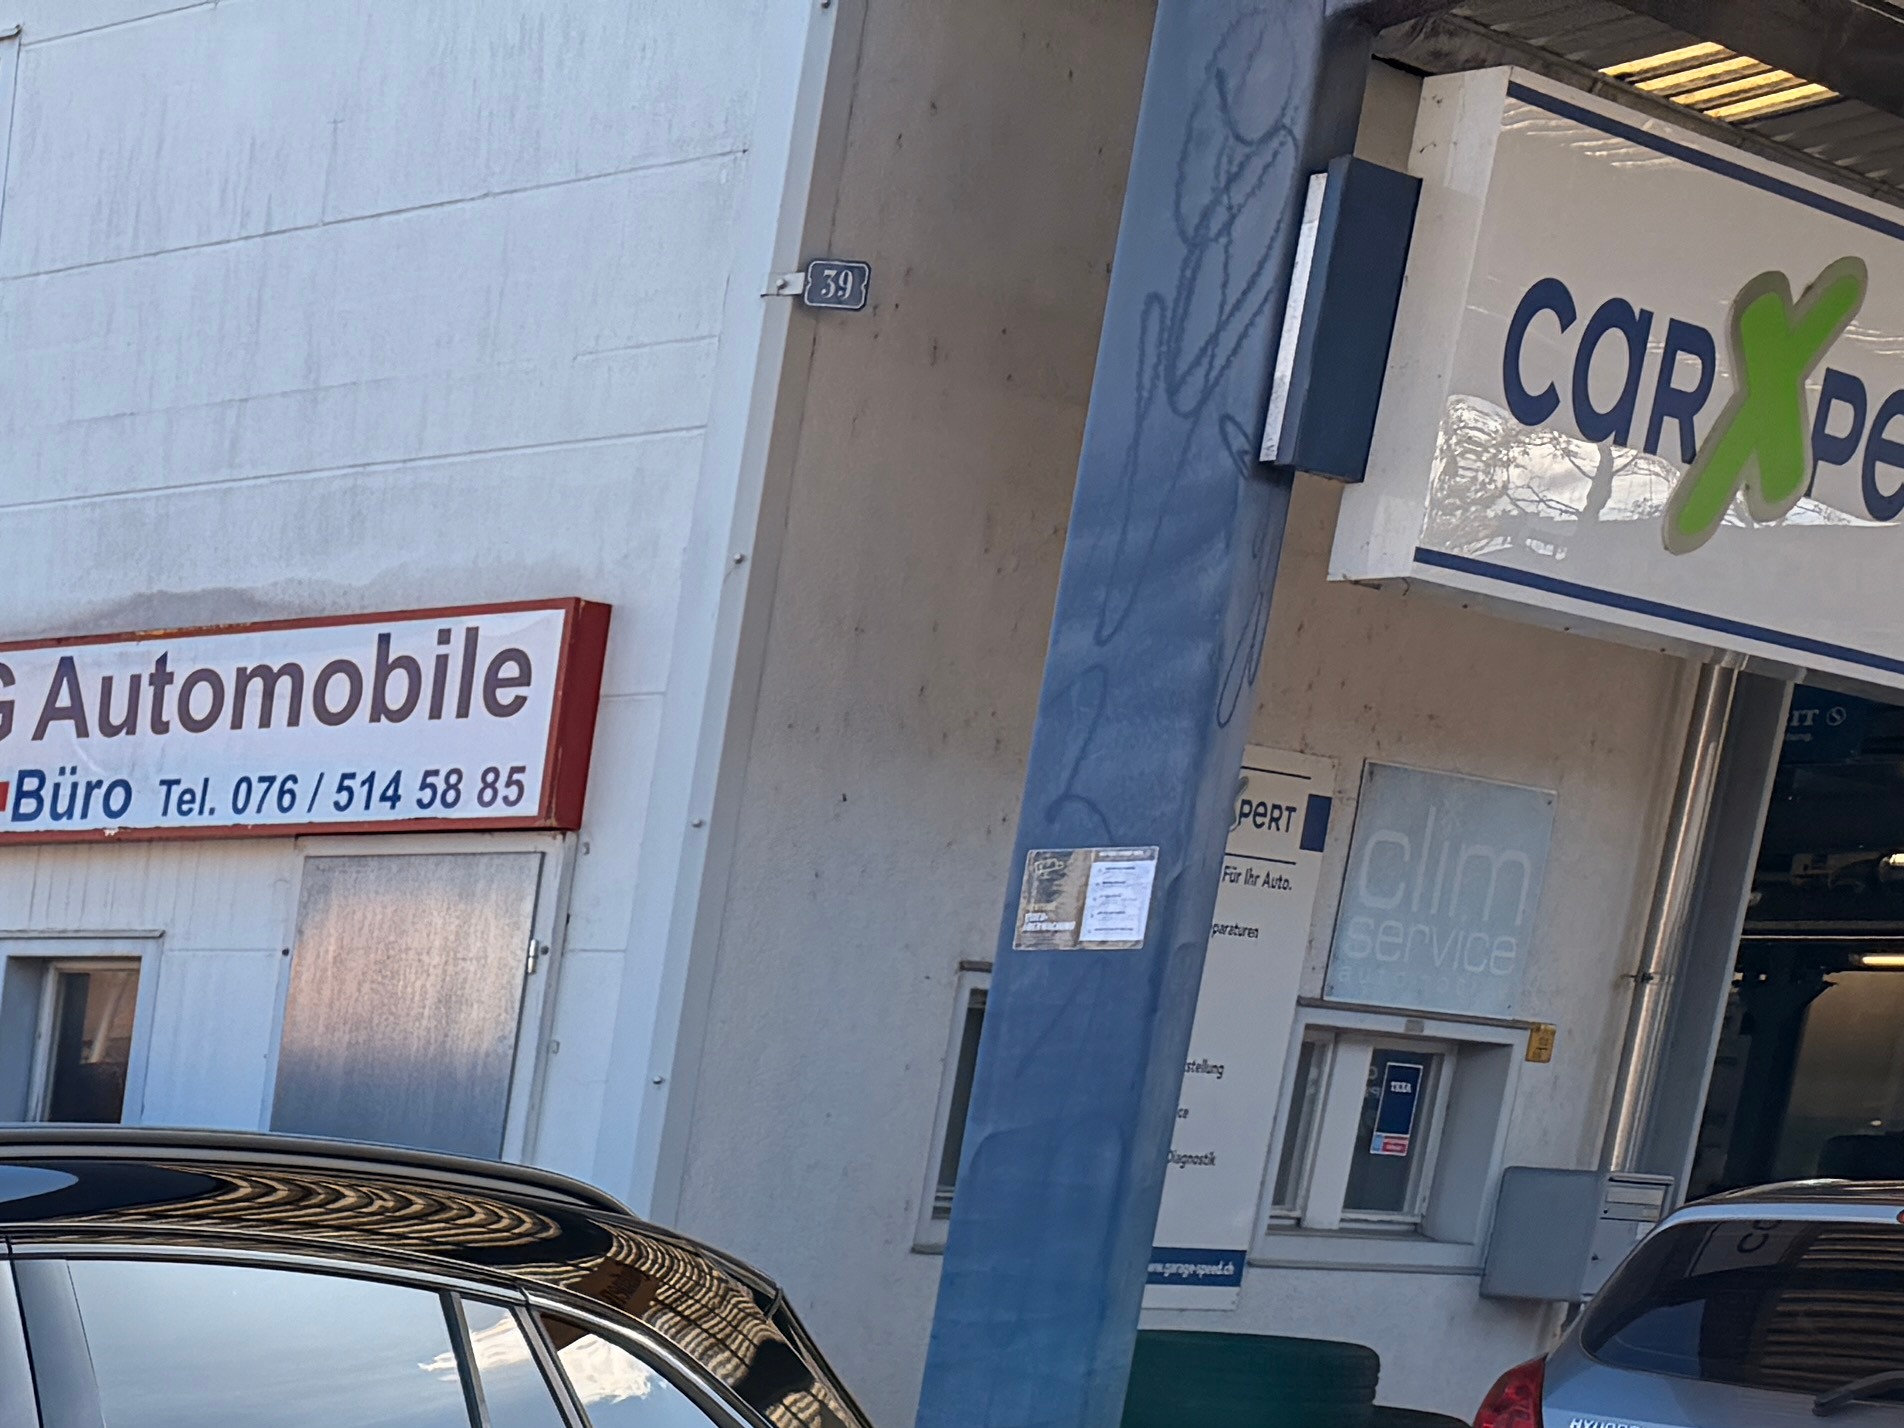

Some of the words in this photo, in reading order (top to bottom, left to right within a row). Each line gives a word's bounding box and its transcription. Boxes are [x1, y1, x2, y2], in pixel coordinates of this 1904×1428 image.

[820, 269, 854, 300] 39
[31, 625, 532, 741] Automobile
[11, 765, 132, 822] Büro
[159, 777, 216, 817] Tel.
[231, 773, 299, 815] 076
[332, 769, 403, 812] 514
[415, 767, 464, 810] 58
[476, 765, 527, 808] 85
[1222, 865, 1242, 884] Für
[1243, 866, 1260, 887] Ihr
[1261, 870, 1293, 891] Auto.
[1359, 803, 1532, 926] clim
[1343, 915, 1517, 976] service
[1185, 1058, 1225, 1080] stellung
